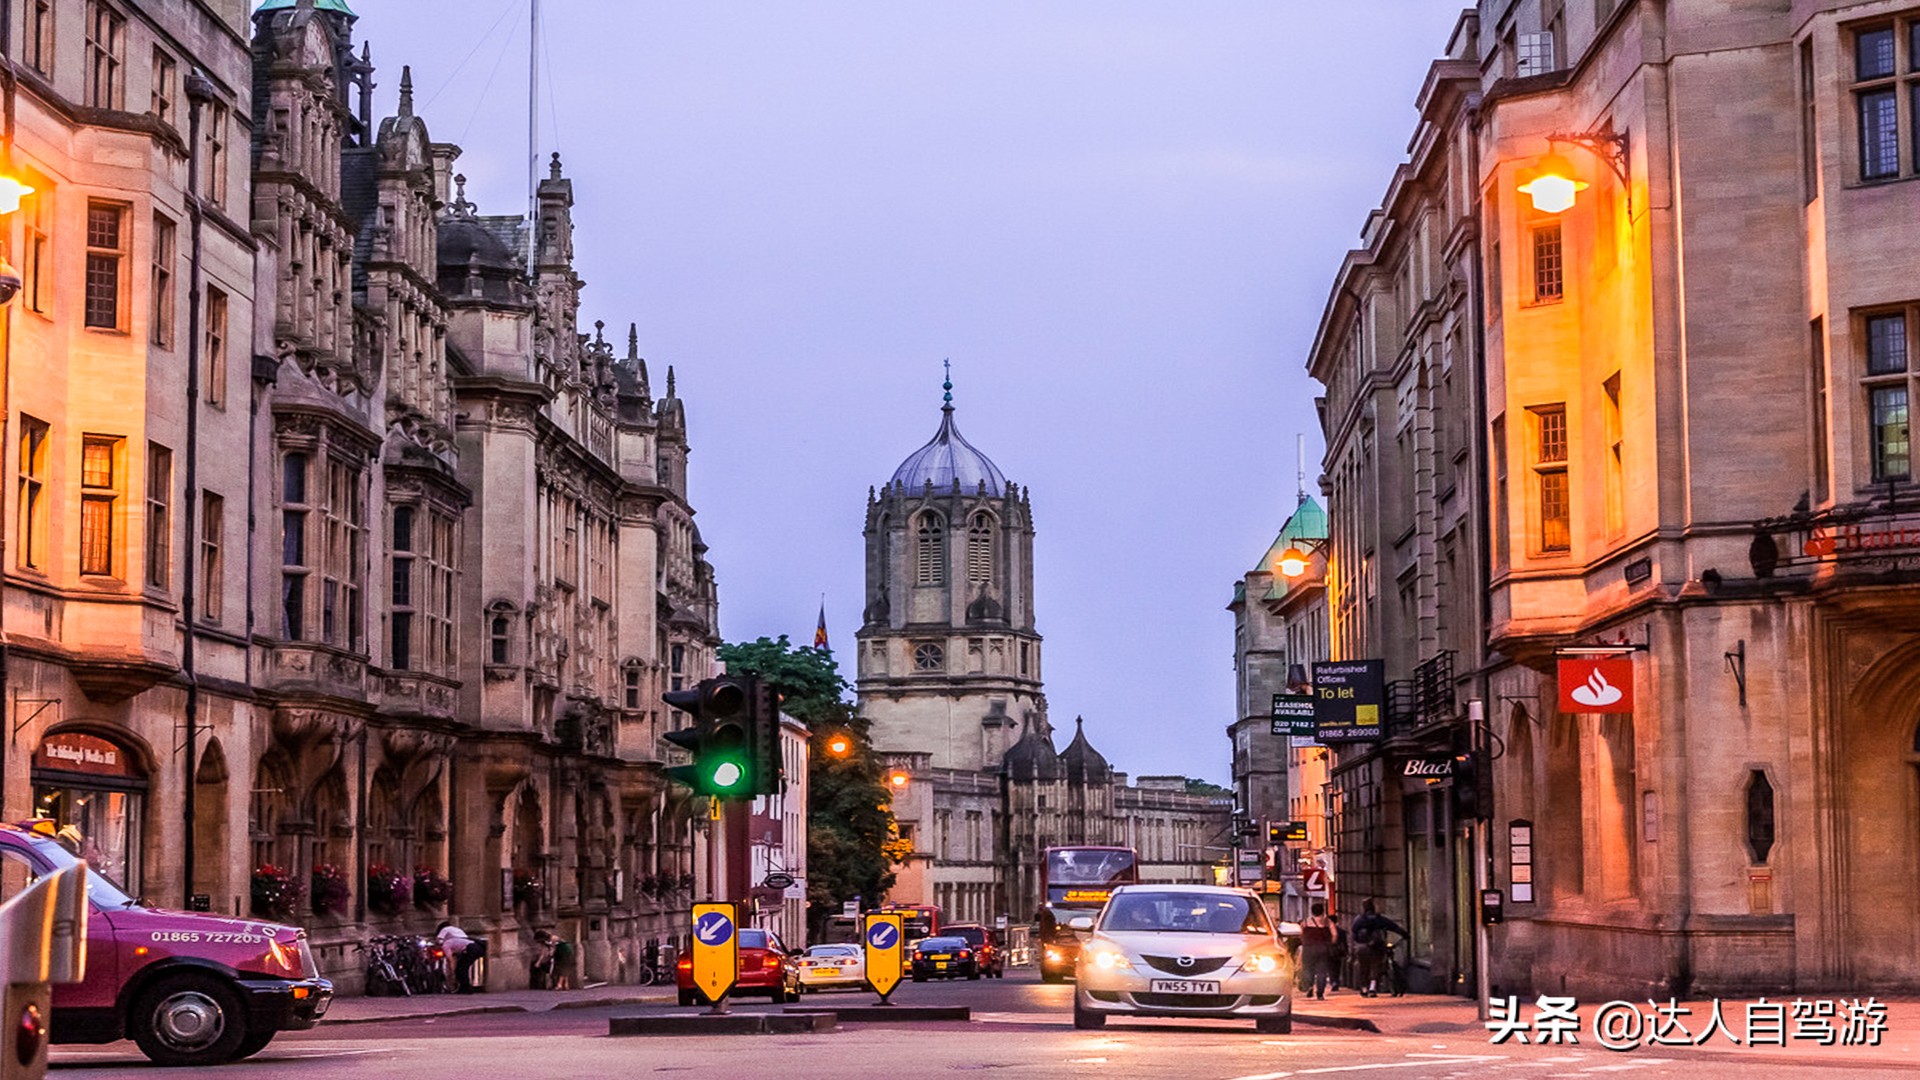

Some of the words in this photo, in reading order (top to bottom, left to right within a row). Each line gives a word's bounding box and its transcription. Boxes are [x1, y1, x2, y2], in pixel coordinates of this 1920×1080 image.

[1316, 665, 1368, 675] Refurbished
[1317, 687, 1335, 699] To
[1337, 686, 1355, 699] let
[1318, 729, 1344, 738] 01865
[1403, 759, 1453, 776] Black
[151, 931, 200, 943] 01865
[204, 932, 262, 944] 727203
[1191, 983, 1214, 992] TYA
